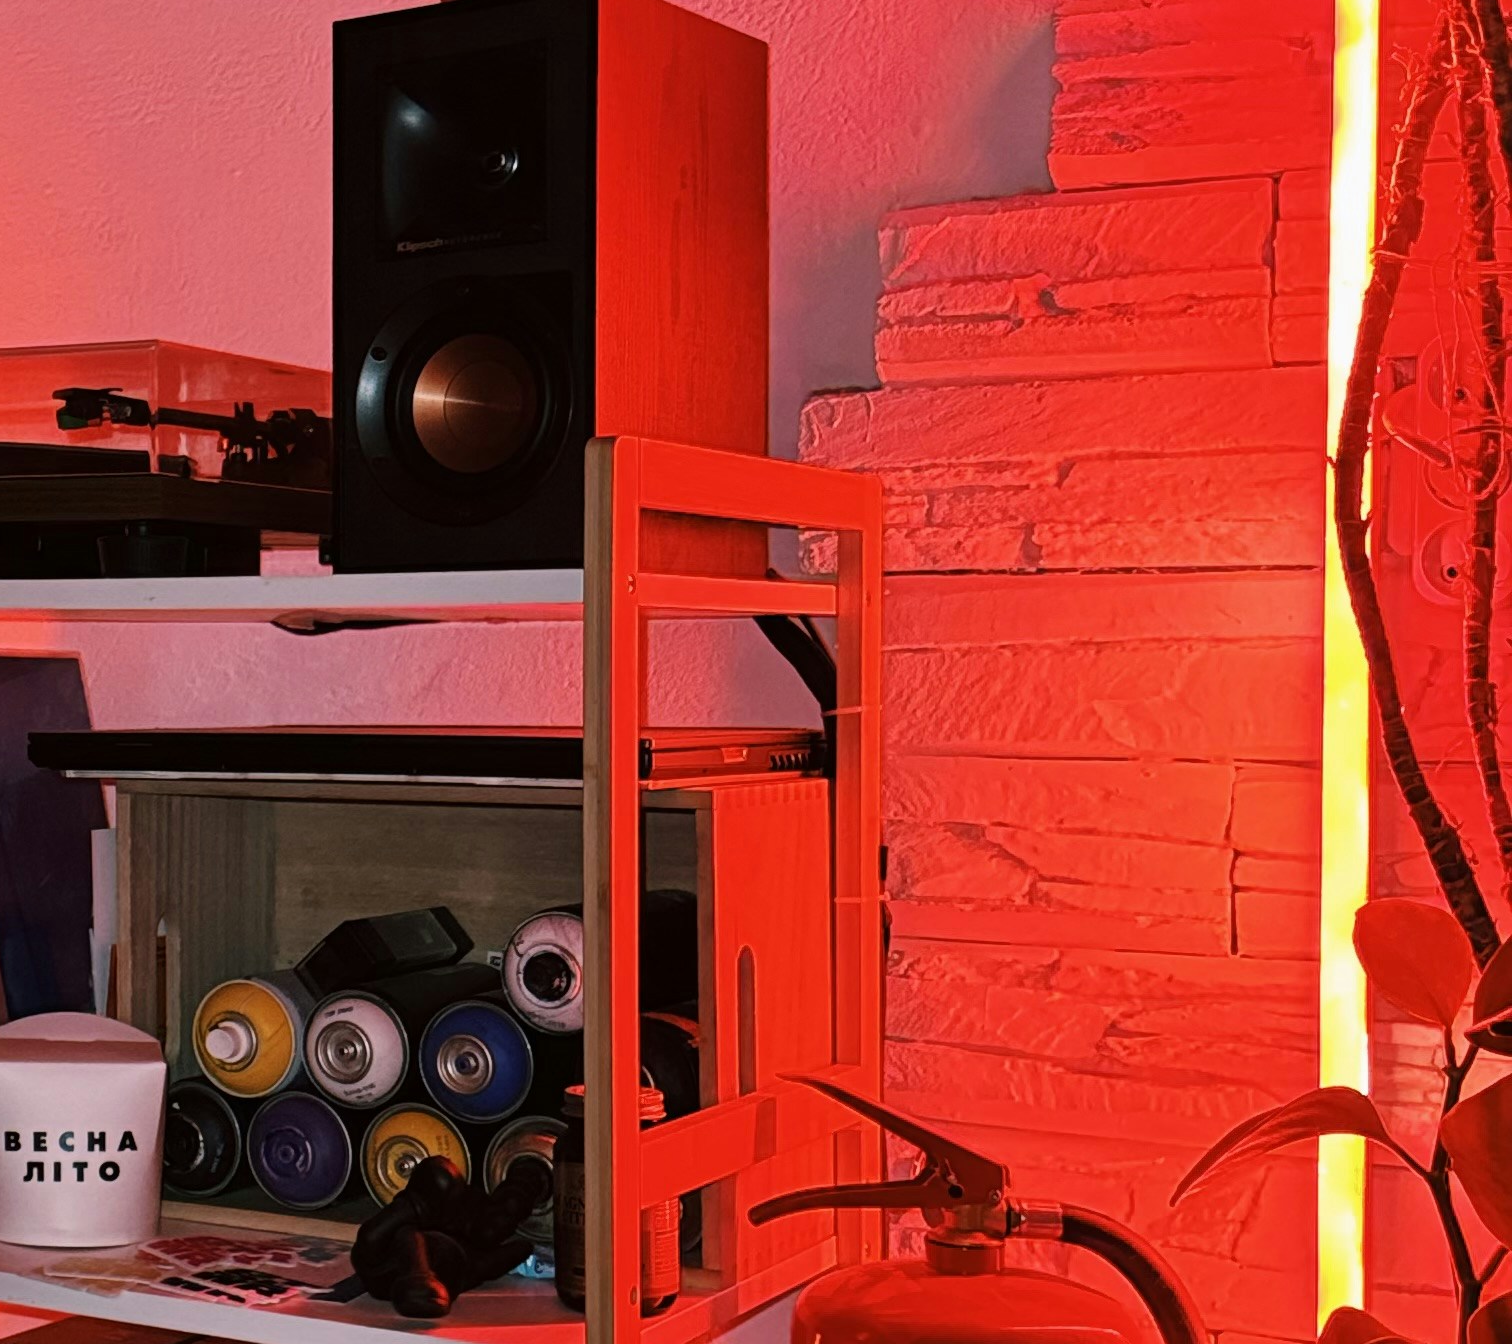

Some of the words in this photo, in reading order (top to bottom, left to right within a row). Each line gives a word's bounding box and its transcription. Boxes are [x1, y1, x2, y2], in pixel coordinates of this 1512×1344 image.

[397, 237, 443, 252] Klipsch
[4, 1131, 138, 1152] ВЕСНА
[23, 1161, 120, 1182] ЛІТО
